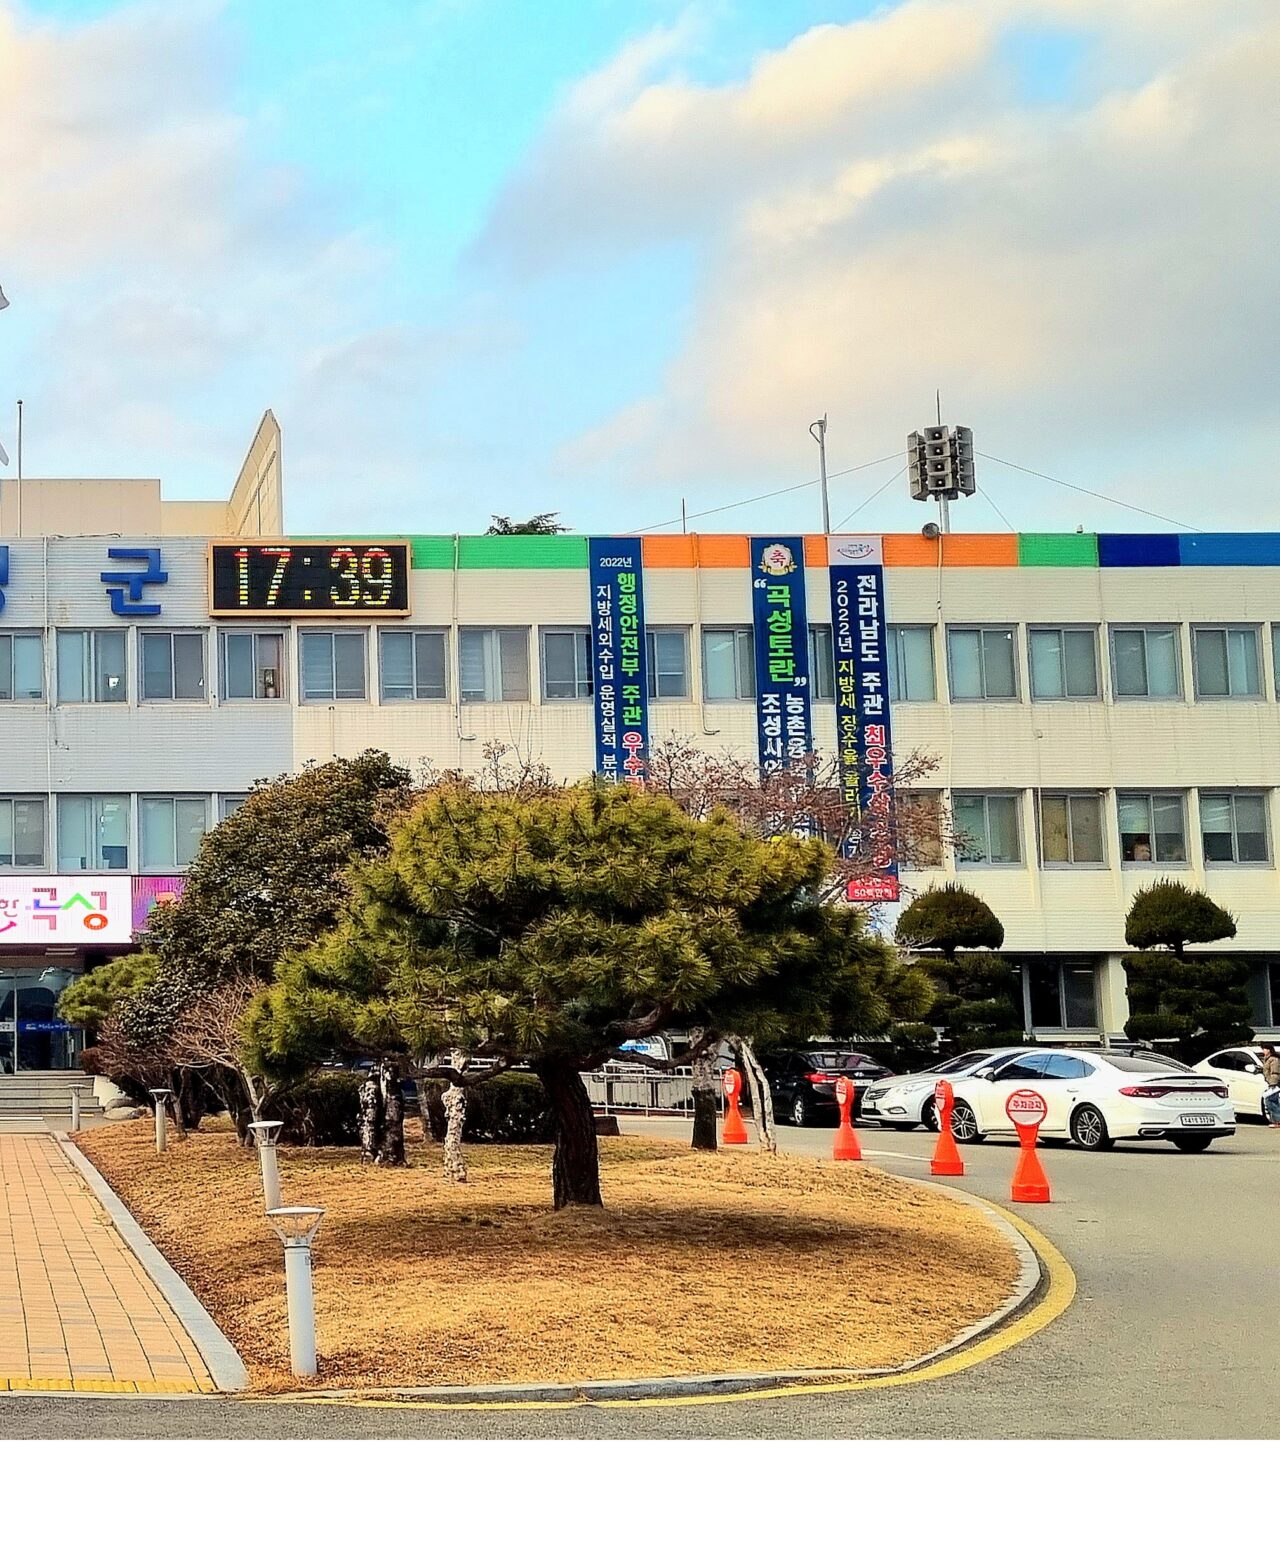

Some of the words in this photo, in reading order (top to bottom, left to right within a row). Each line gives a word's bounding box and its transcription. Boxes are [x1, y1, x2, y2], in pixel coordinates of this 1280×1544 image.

[234, 547, 393, 606] 17:39
[599, 557, 632, 568] 2022년
[769, 549, 786, 567] 축
[596, 584, 614, 680] 지방세외수입
[616, 572, 639, 677] 행정안전부
[836, 580, 853, 653] 2022년
[856, 574, 881, 663] 전라남도
[621, 685, 643, 726] 주관
[838, 659, 856, 710] 지방세
[861, 671, 883, 716] 주관
[599, 685, 616, 749] 운영실적
[840, 714, 858, 766] 징수율
[31, 887, 109, 931] 곡성
